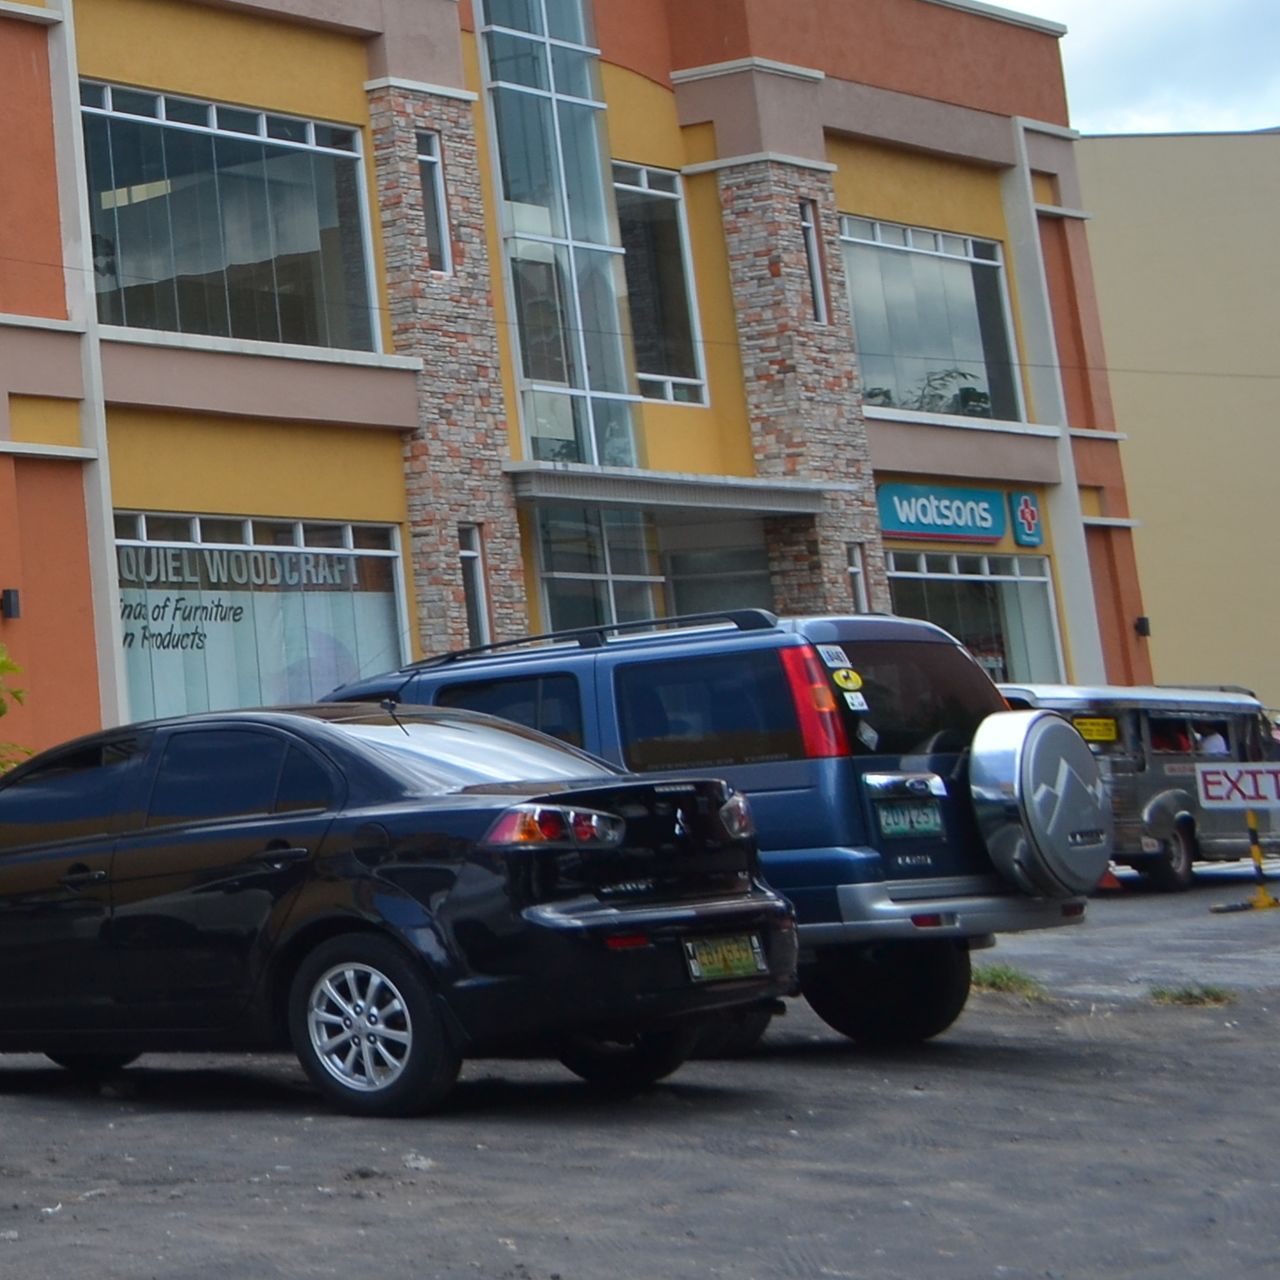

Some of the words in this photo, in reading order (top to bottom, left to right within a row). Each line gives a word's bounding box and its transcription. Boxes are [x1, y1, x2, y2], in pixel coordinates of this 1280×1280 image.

[893, 495, 993, 528] watsons
[151, 596, 171, 622] of
[172, 597, 244, 622] Furniture
